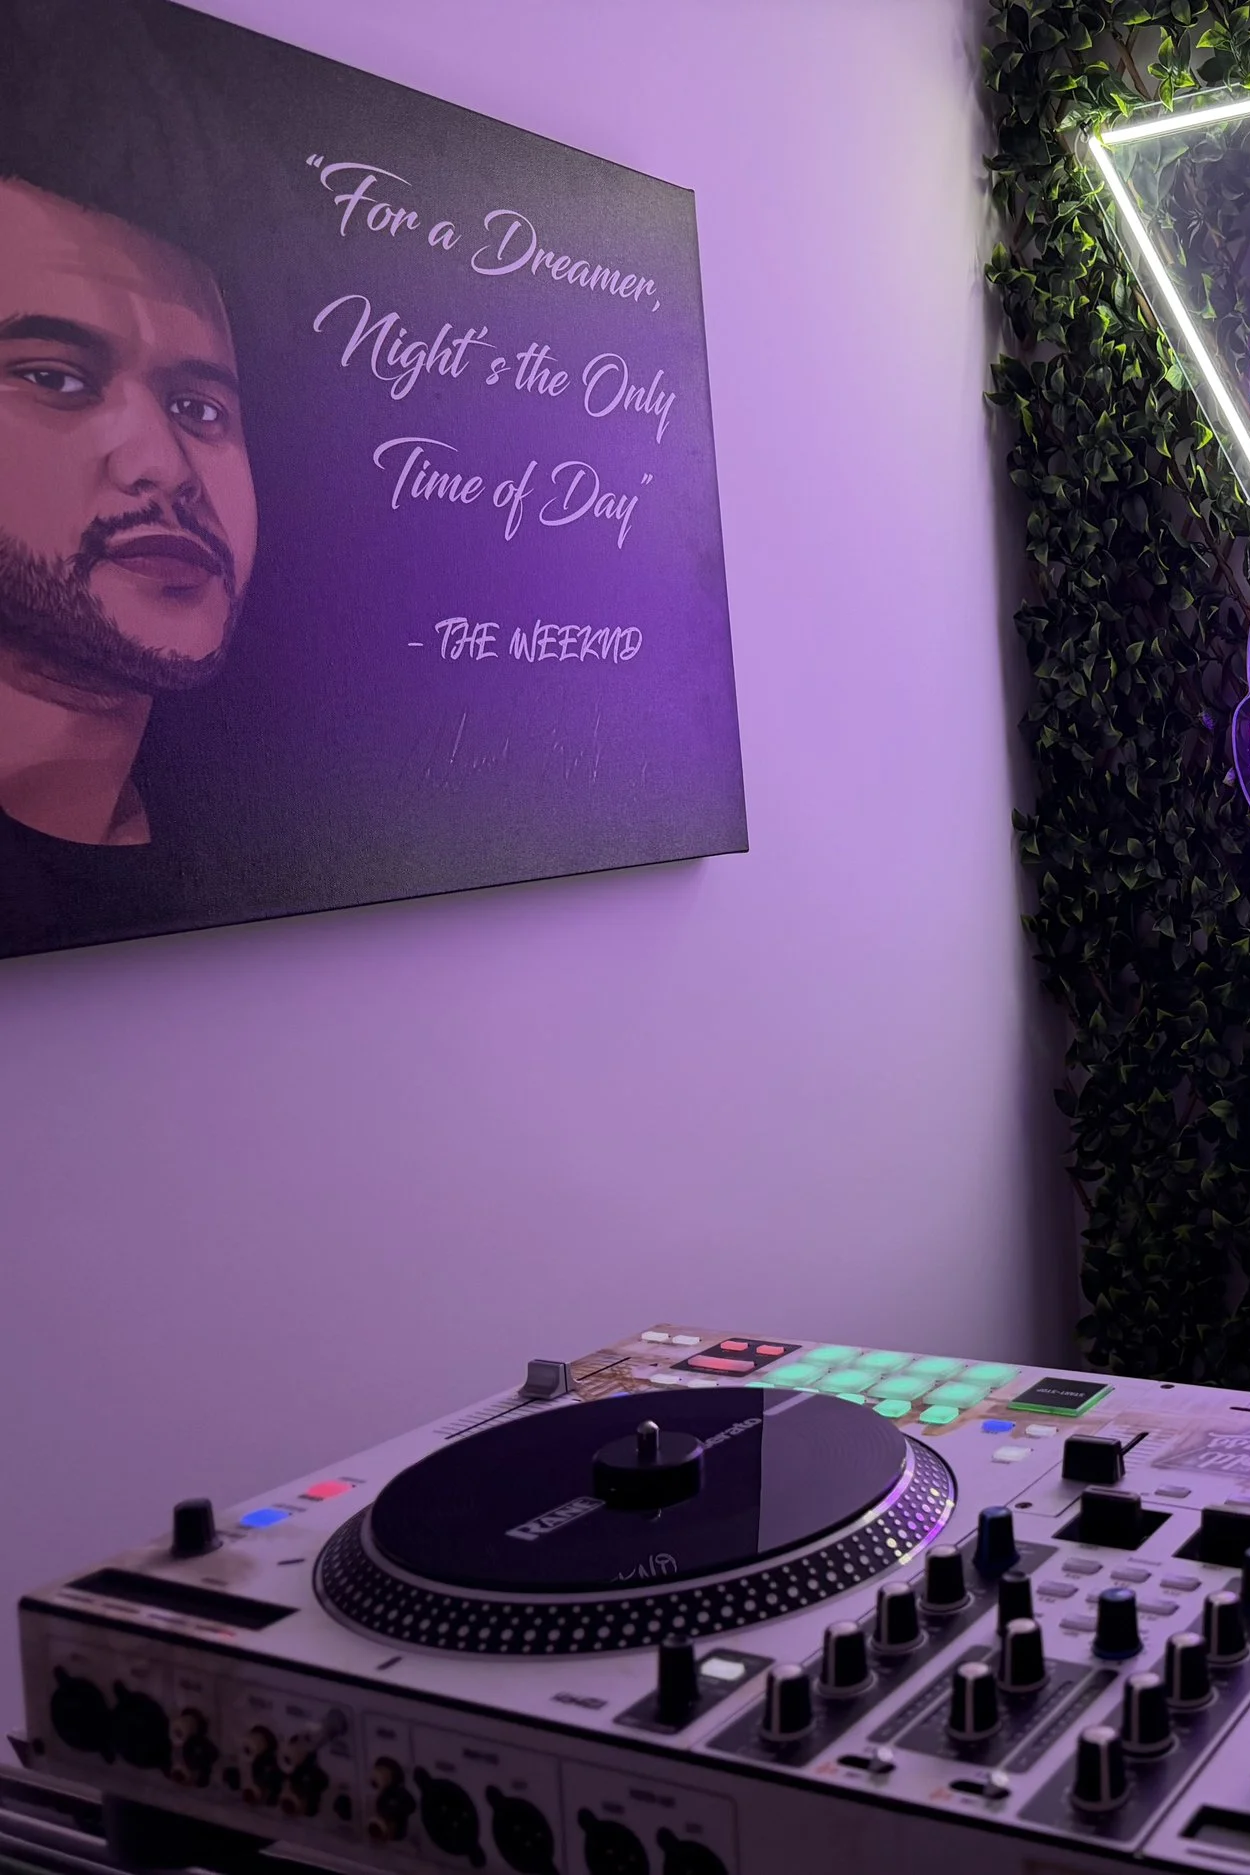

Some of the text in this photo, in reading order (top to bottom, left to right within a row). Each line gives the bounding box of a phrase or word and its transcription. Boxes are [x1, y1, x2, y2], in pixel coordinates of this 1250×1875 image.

[427, 220, 462, 250] a
[470, 209, 660, 313] Dreamer,
[516, 342, 570, 396] the
[582, 353, 676, 444] Only
[373, 437, 485, 510] Time
[493, 459, 539, 541] of
[434, 616, 500, 661] THE
[509, 619, 642, 664] WEEKND
[505, 1497, 605, 1541] RANE
